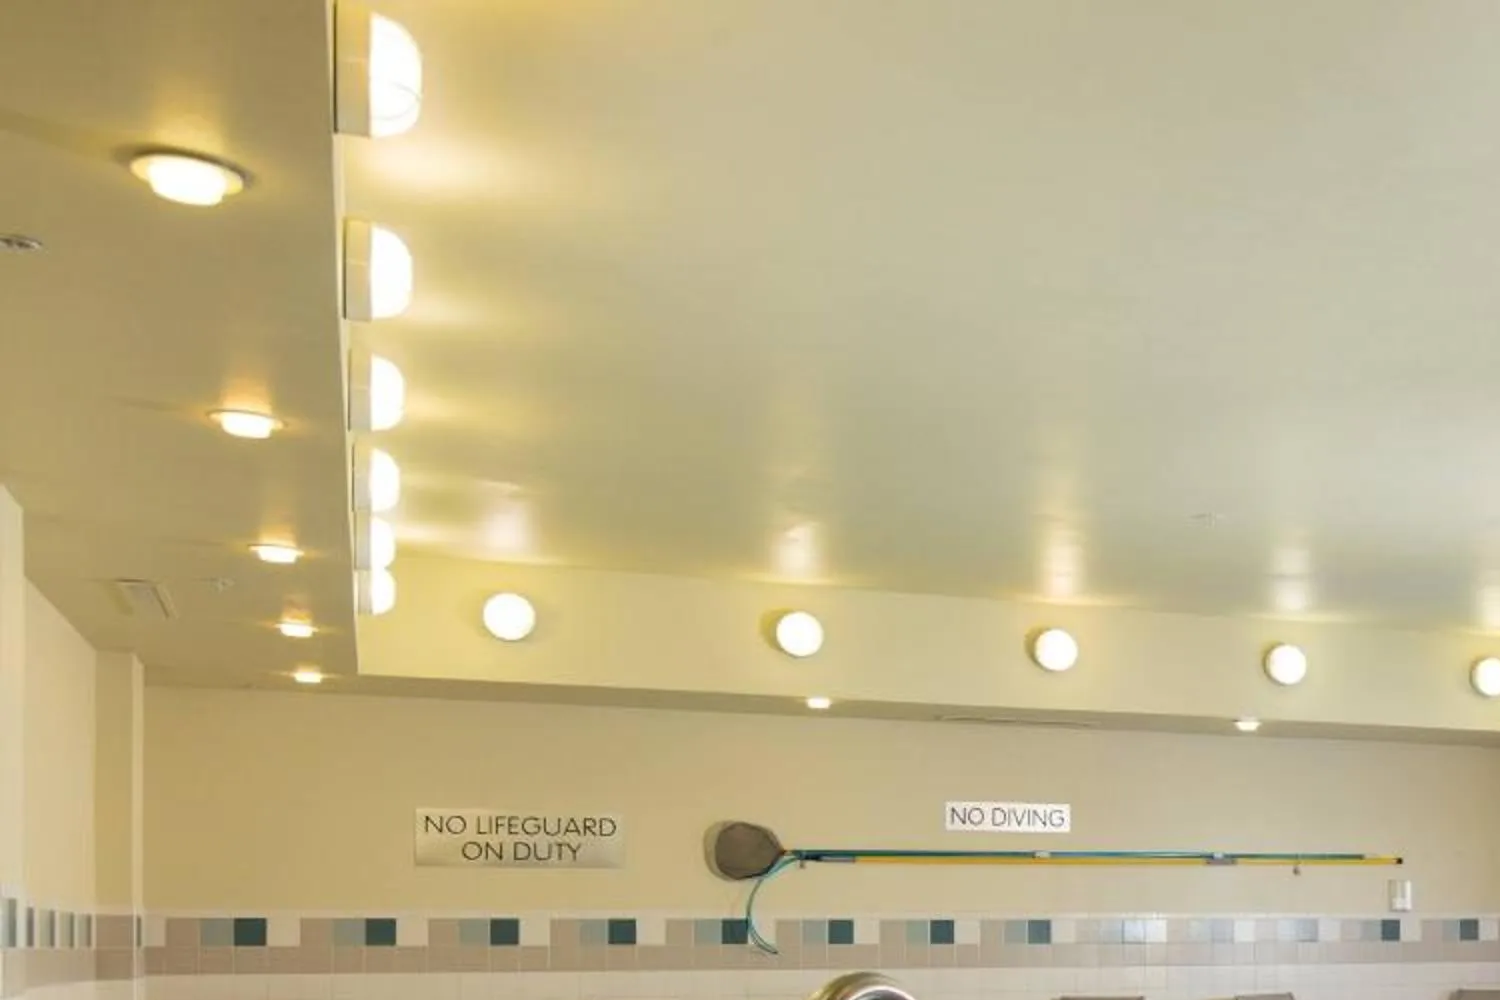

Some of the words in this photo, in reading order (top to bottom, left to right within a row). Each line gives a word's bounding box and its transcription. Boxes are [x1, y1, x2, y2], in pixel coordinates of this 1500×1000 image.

[424, 815, 467, 835] NO
[476, 815, 617, 837] LIFEGUARD
[950, 807, 985, 827] NO
[991, 807, 1065, 828] DIVING
[461, 841, 505, 861] ON
[513, 841, 582, 862] DUTY
